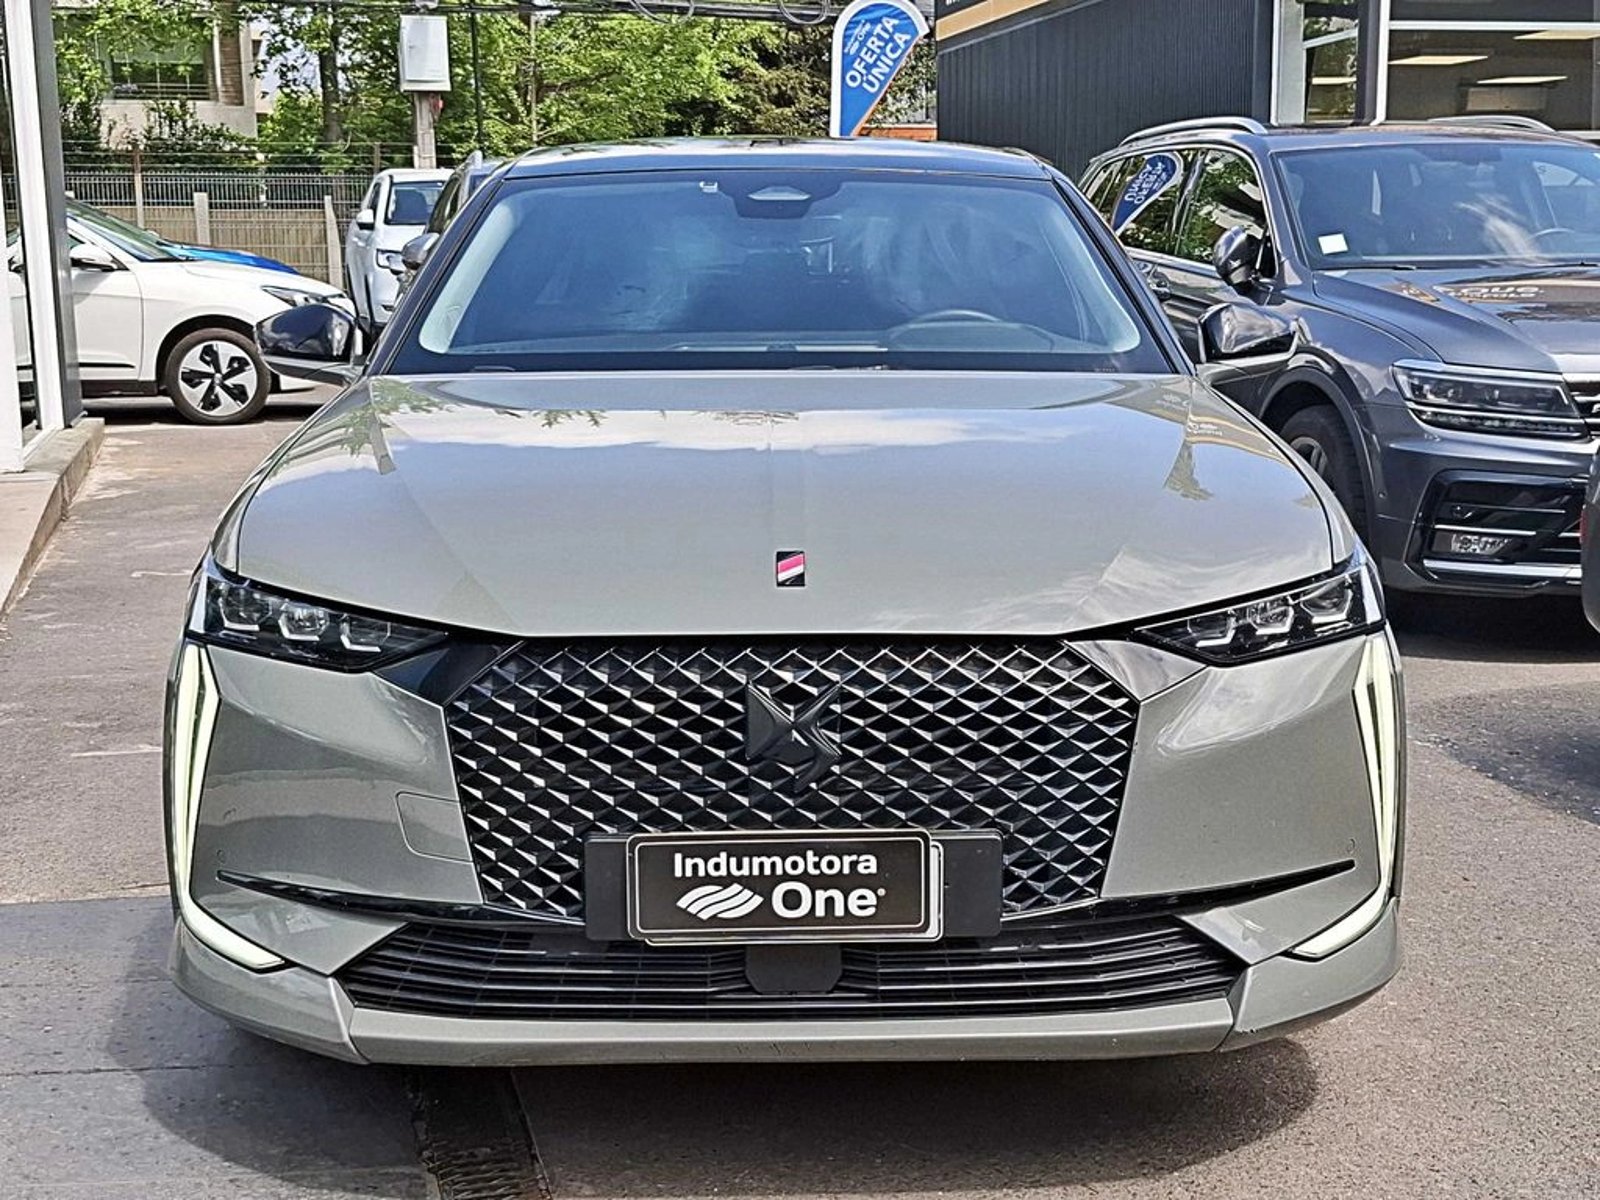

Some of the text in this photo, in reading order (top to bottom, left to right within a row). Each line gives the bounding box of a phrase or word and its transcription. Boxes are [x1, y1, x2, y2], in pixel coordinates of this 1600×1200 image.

[845, 16, 900, 88] OFERTA
[862, 32, 912, 93] ÚNICA
[674, 850, 878, 878] Indumotora
[771, 881, 879, 919] One
